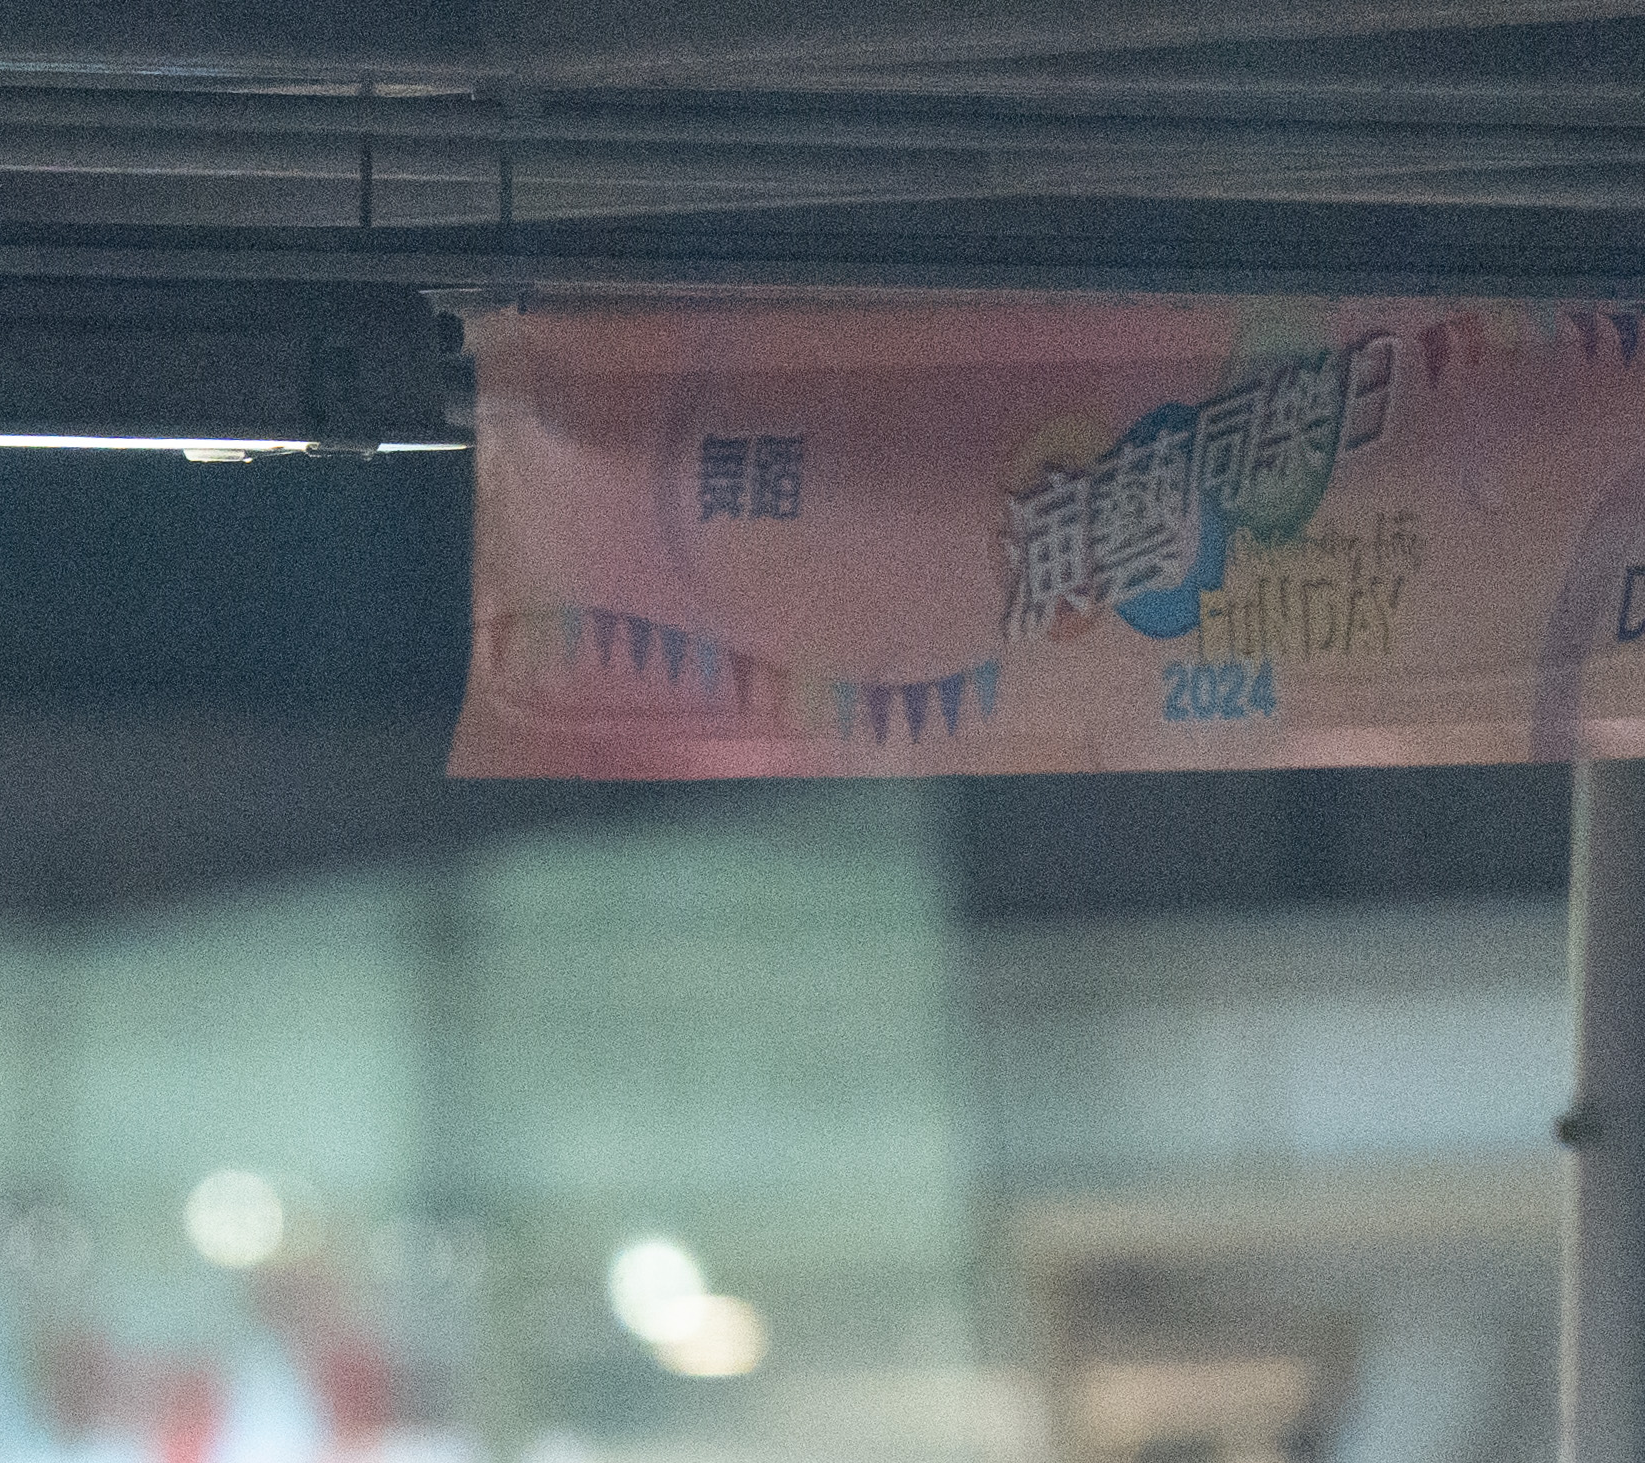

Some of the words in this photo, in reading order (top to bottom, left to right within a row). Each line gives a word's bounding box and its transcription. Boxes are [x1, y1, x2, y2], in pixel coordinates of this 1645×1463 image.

[1001, 334, 1403, 642] 演藝同樂日
[1161, 660, 1277, 720] 2024
